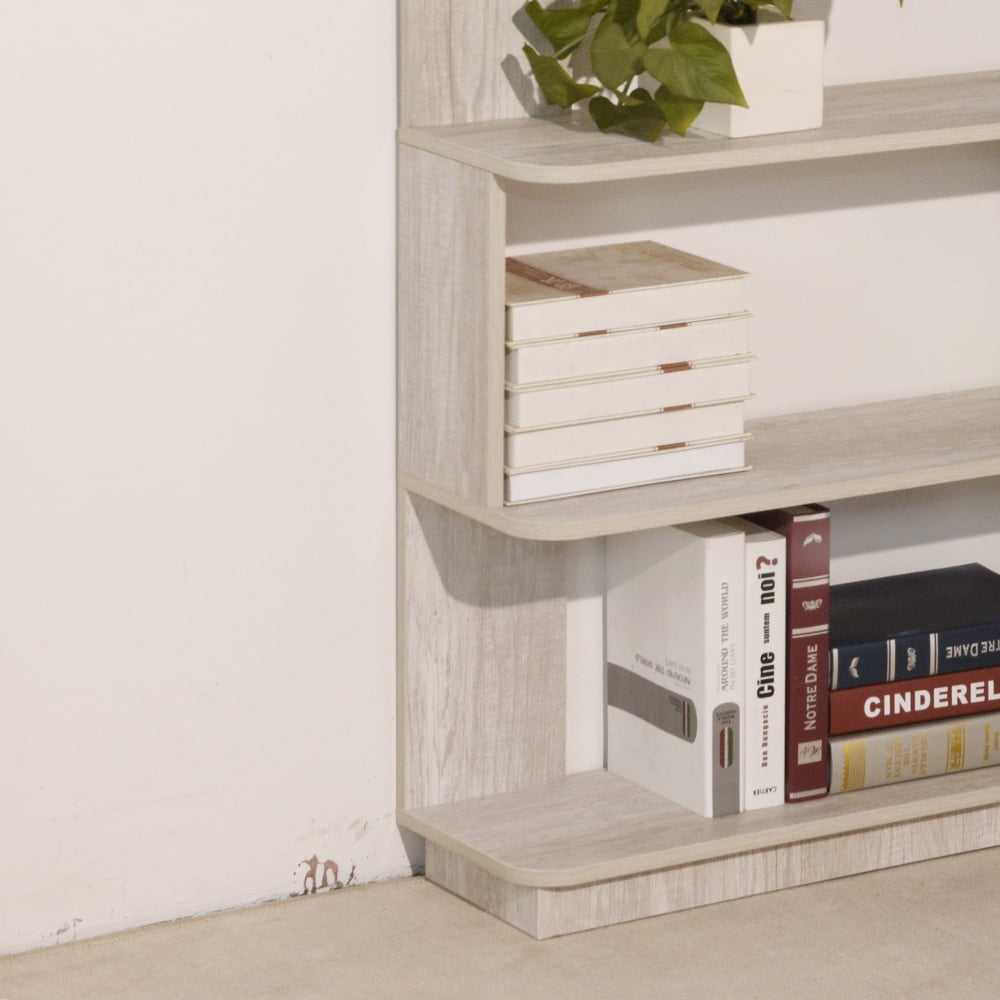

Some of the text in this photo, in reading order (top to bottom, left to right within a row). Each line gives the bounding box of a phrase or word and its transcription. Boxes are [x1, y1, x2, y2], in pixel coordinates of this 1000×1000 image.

[721, 581, 729, 620] WORLD
[756, 555, 778, 605] noi?
[720, 648, 729, 692] AROUND
[804, 644, 818, 684] DAME
[946, 642, 979, 659] DAME
[756, 651, 774, 699] Cine
[804, 685, 816, 731] NOTRE
